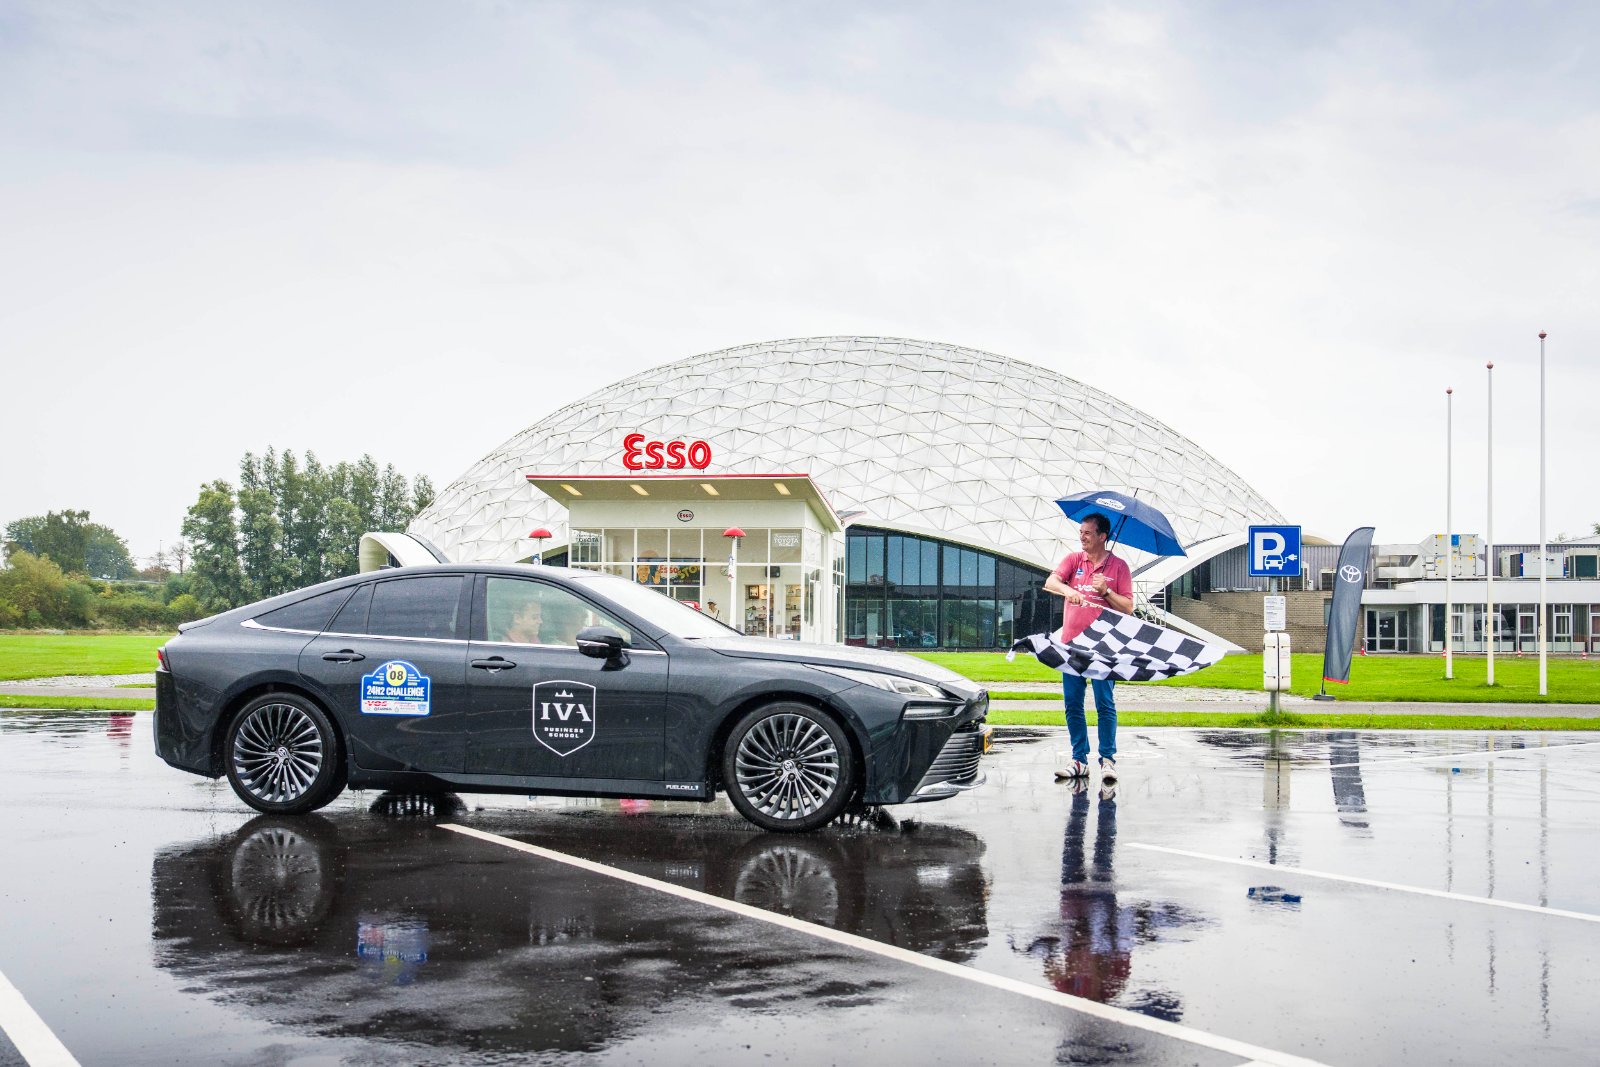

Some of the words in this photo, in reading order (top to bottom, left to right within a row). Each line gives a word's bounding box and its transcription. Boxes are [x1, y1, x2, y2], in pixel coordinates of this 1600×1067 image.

[623, 433, 712, 470] Esso
[1254, 532, 1286, 570] P
[390, 671, 403, 680] 08
[367, 685, 385, 695] 24H2
[386, 687, 424, 696] CHALLENGE
[540, 702, 592, 721] IVA
